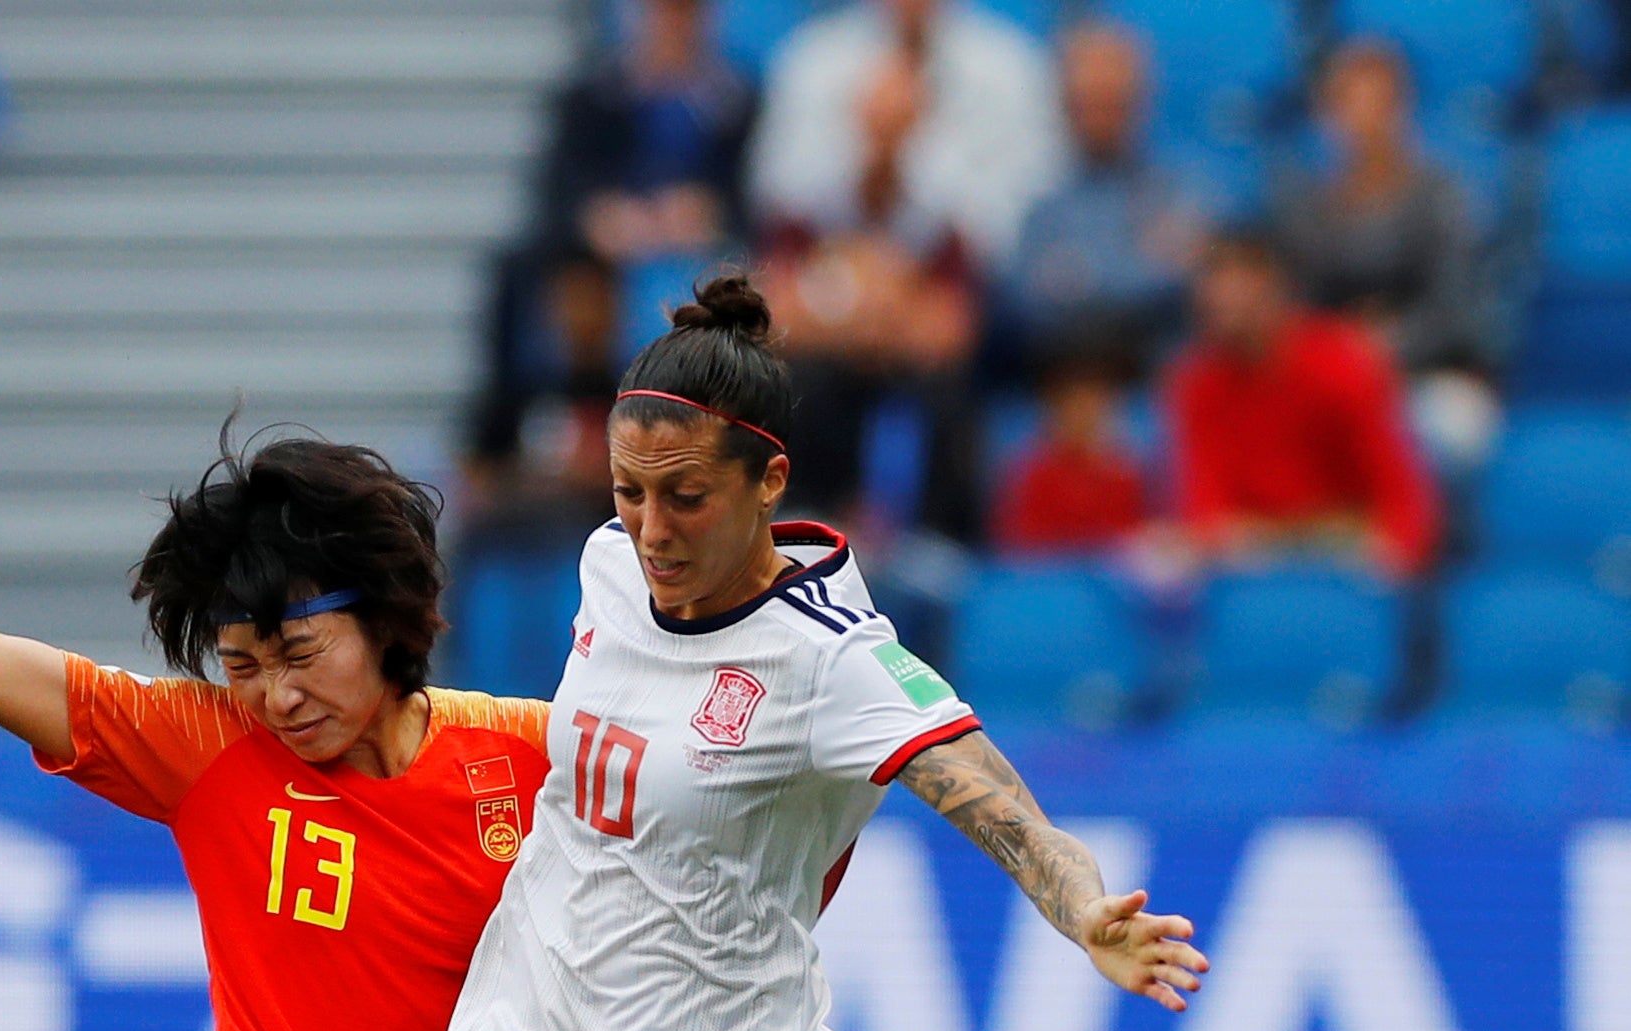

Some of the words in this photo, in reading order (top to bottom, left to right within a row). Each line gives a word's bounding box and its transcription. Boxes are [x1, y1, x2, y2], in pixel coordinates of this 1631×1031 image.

[479, 799, 515, 816] CFA
[571, 708, 650, 840] 10
[266, 806, 358, 931] 13
